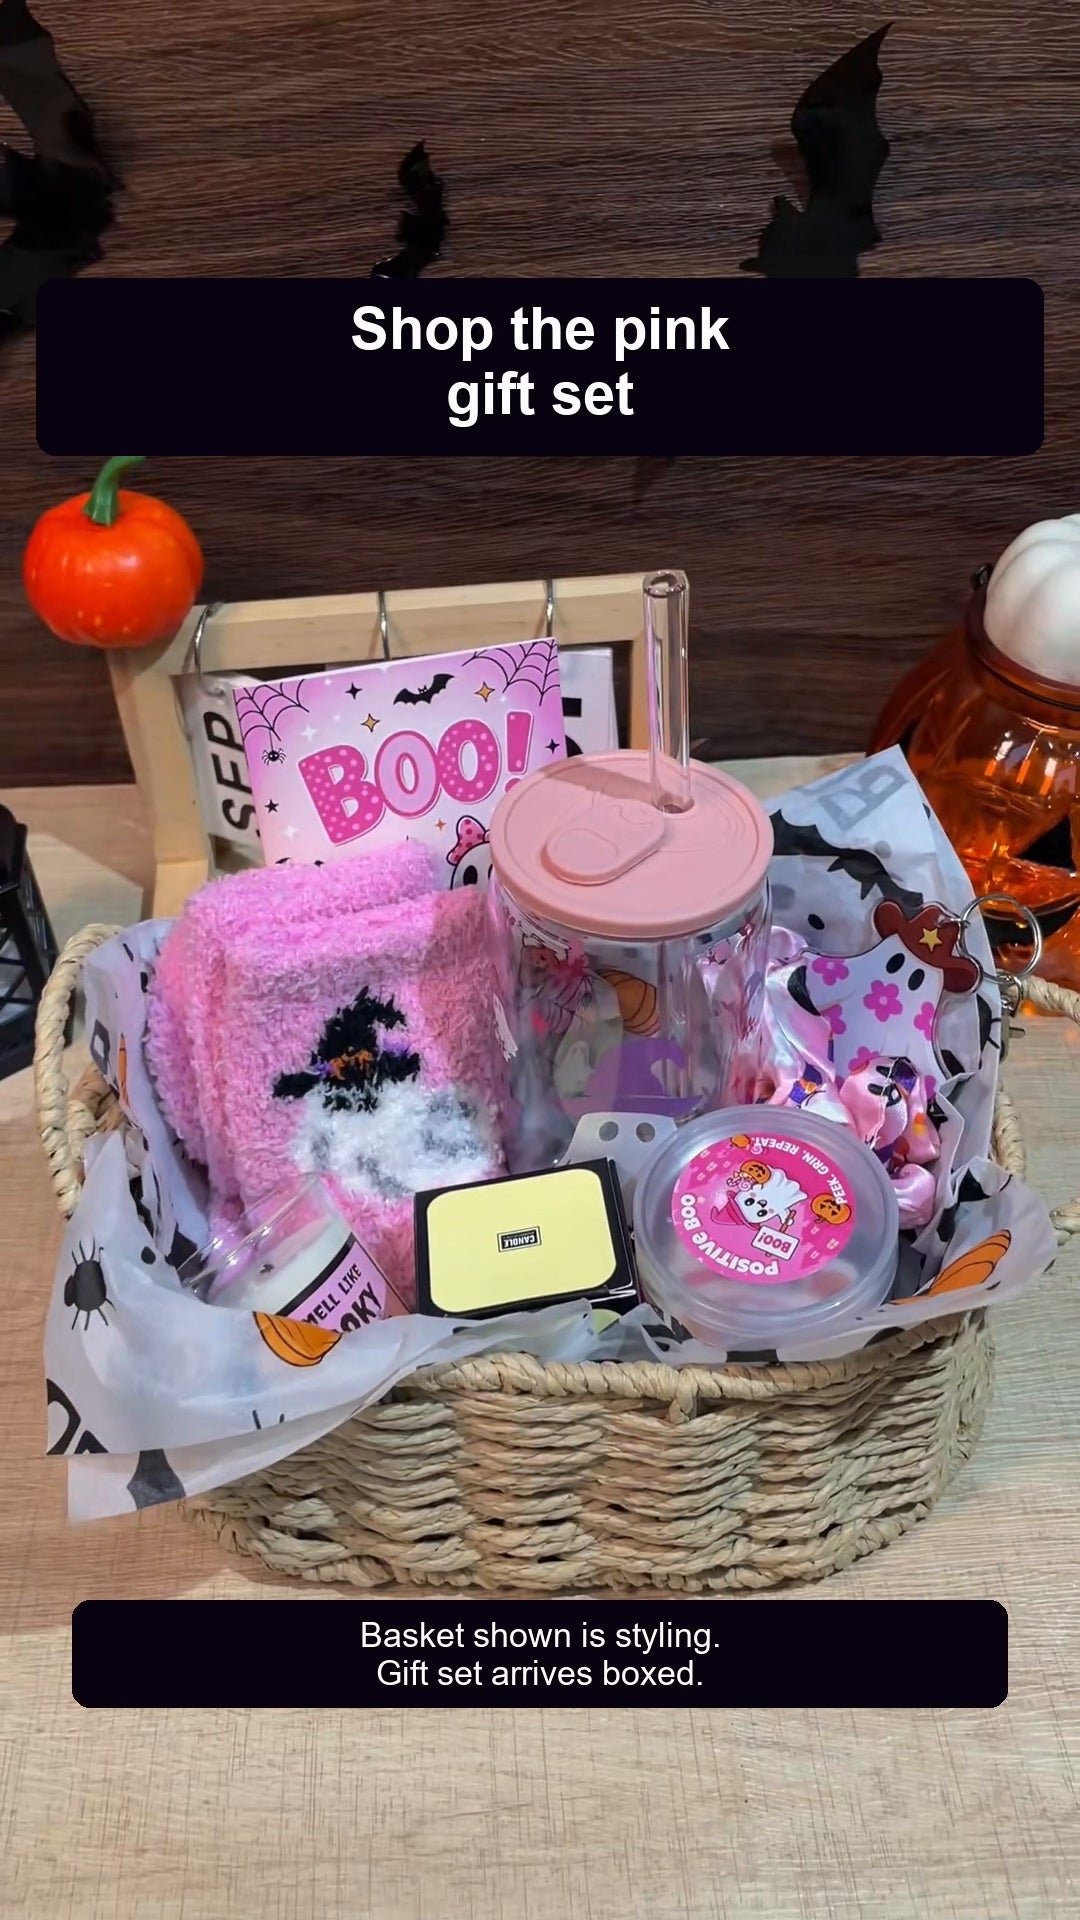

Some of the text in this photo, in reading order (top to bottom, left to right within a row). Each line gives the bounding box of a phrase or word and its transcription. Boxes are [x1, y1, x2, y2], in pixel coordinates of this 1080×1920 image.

[297, 710, 535, 847] BOO!
[750, 1136, 848, 1205] PEEK. GRIN. REPEAT.
[680, 1193, 702, 1232] BOO
[503, 1234, 535, 1248] CANDLE
[758, 1232, 793, 1254] BOO!
[302, 1263, 362, 1325] MELL LIKE
